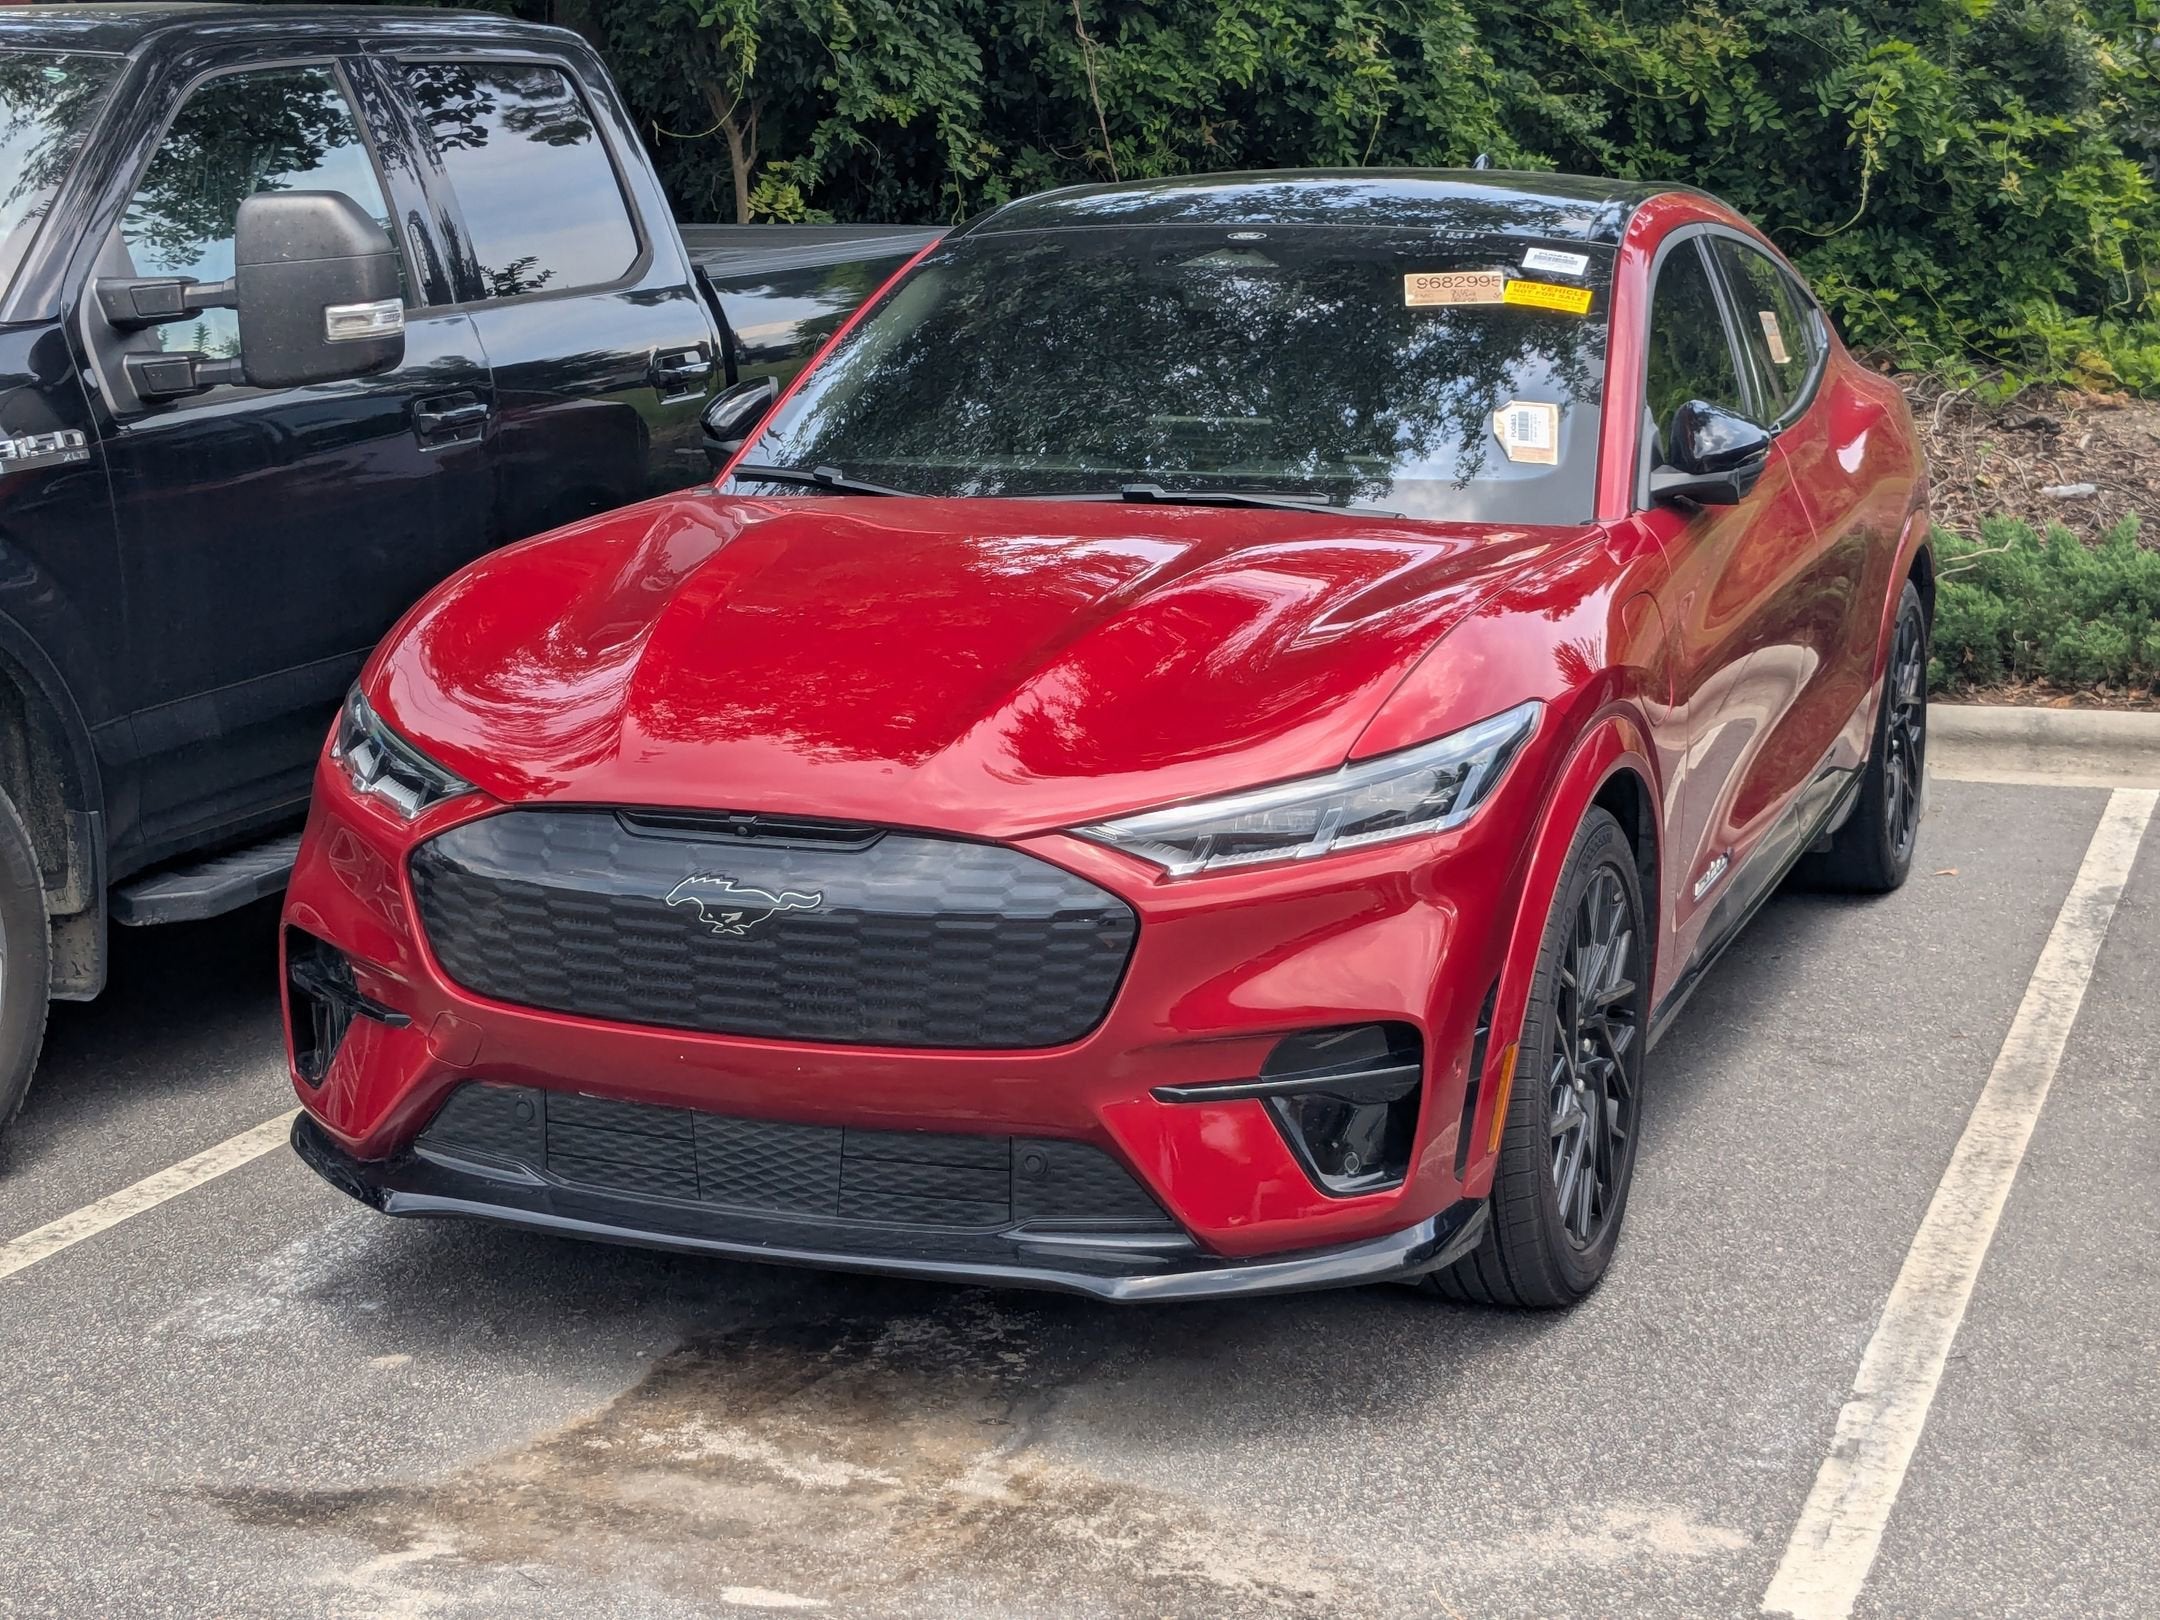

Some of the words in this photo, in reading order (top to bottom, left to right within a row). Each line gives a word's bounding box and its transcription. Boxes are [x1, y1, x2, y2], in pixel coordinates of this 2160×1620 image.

[1416, 275, 1502, 289] 9682995
[1513, 282, 1537, 290] THIS
[1541, 285, 1588, 298] VEHICLE
[1558, 294, 1583, 302] SALE
[63, 450, 86, 462] XLT
